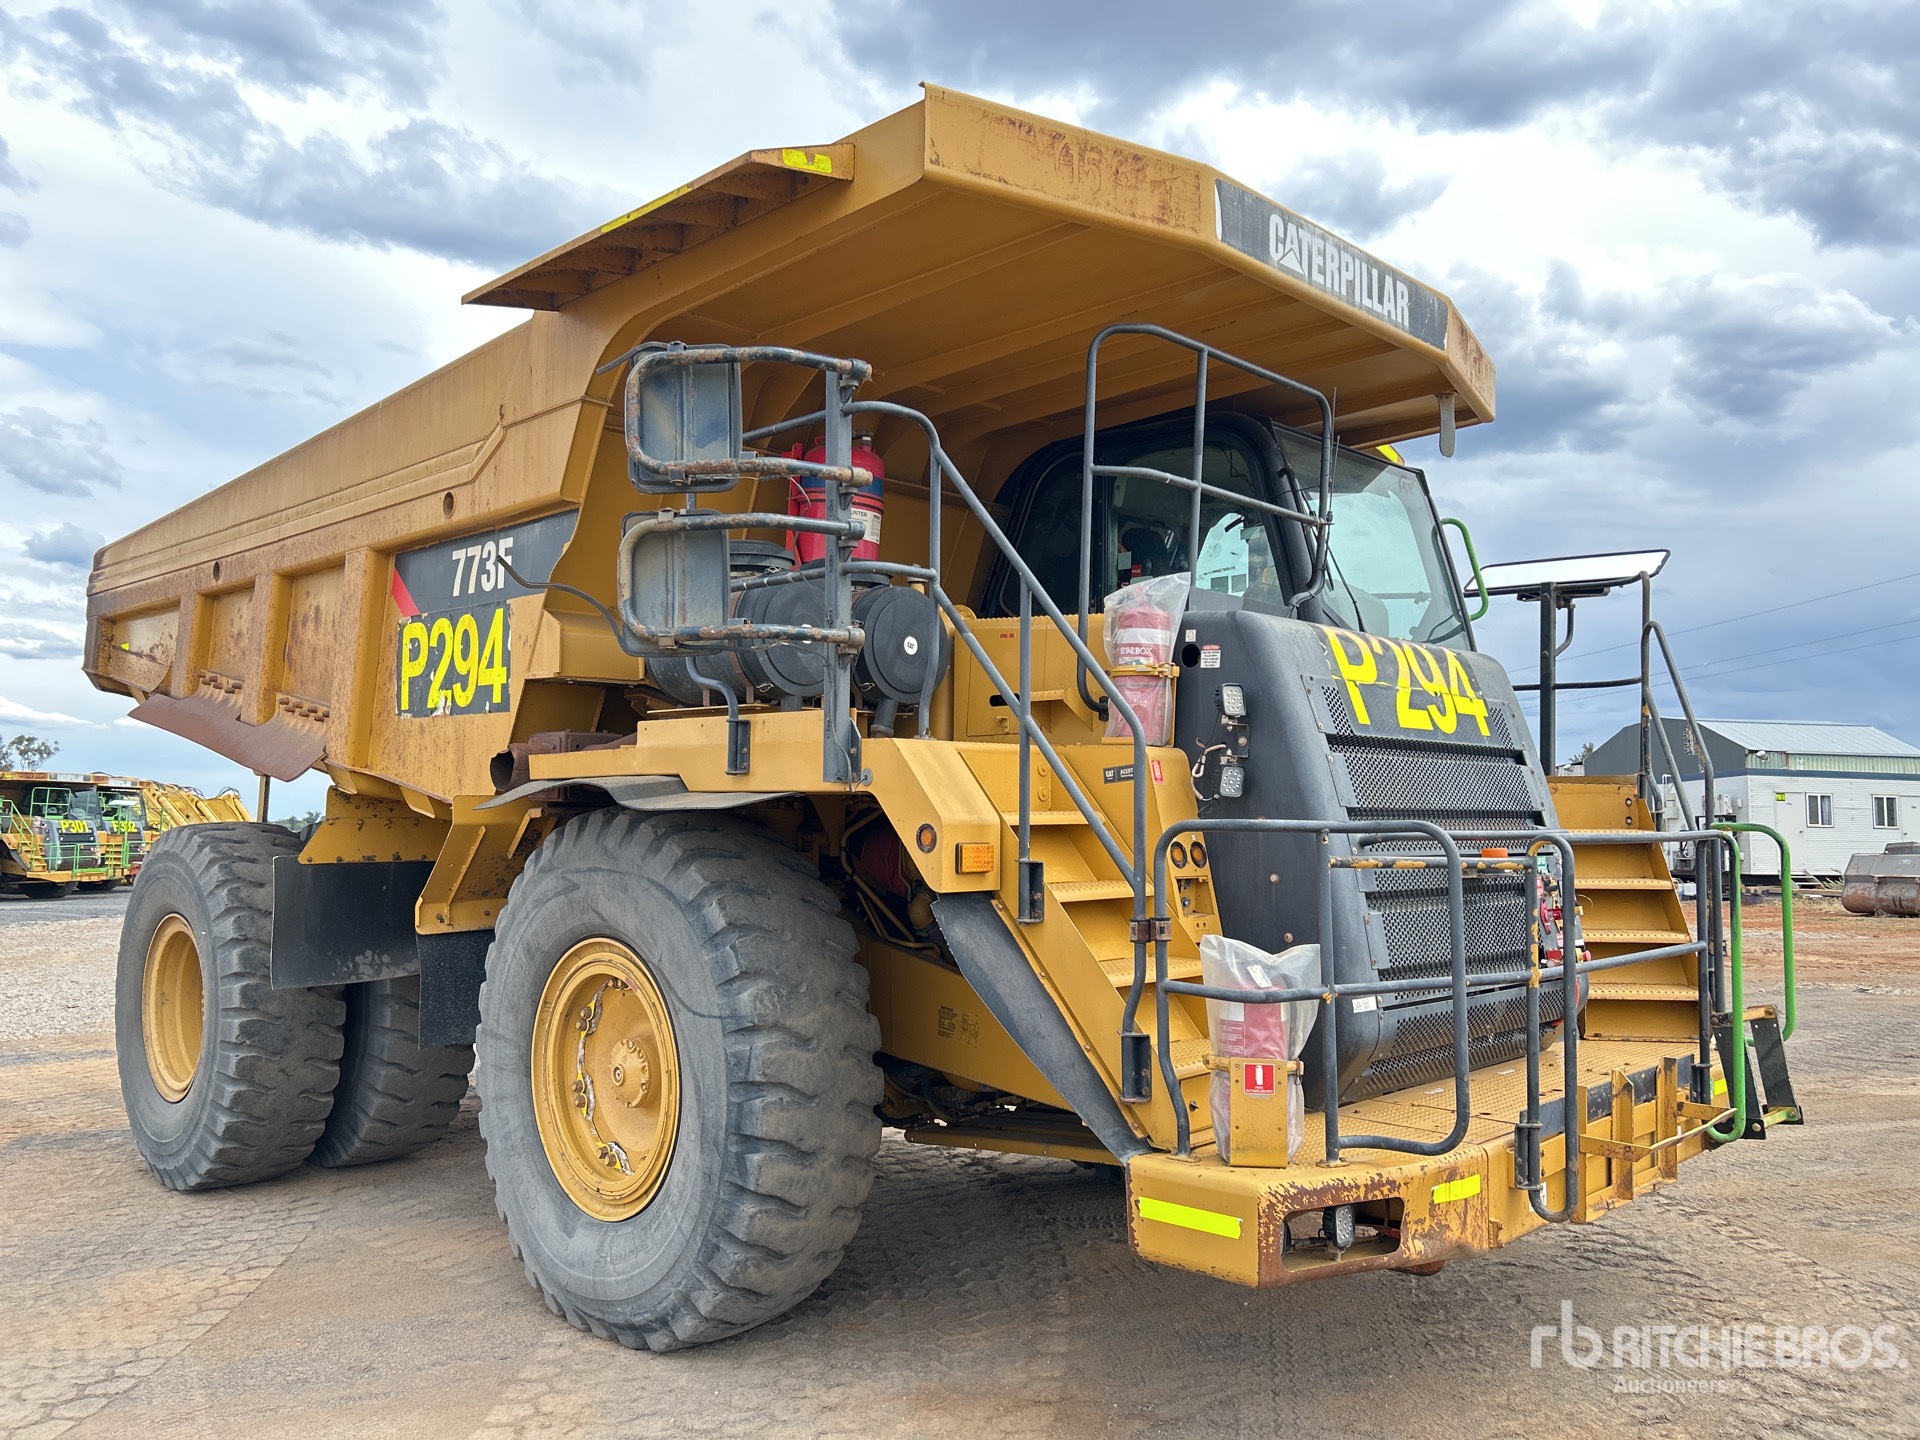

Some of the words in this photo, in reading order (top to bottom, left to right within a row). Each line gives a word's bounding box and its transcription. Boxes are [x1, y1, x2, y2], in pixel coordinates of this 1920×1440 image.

[1269, 213, 1409, 327] CATERPILLAR
[452, 537, 513, 597] 773F
[401, 608, 507, 710] P294
[1323, 625, 1490, 737] P294
[60, 820, 88, 833] P301
